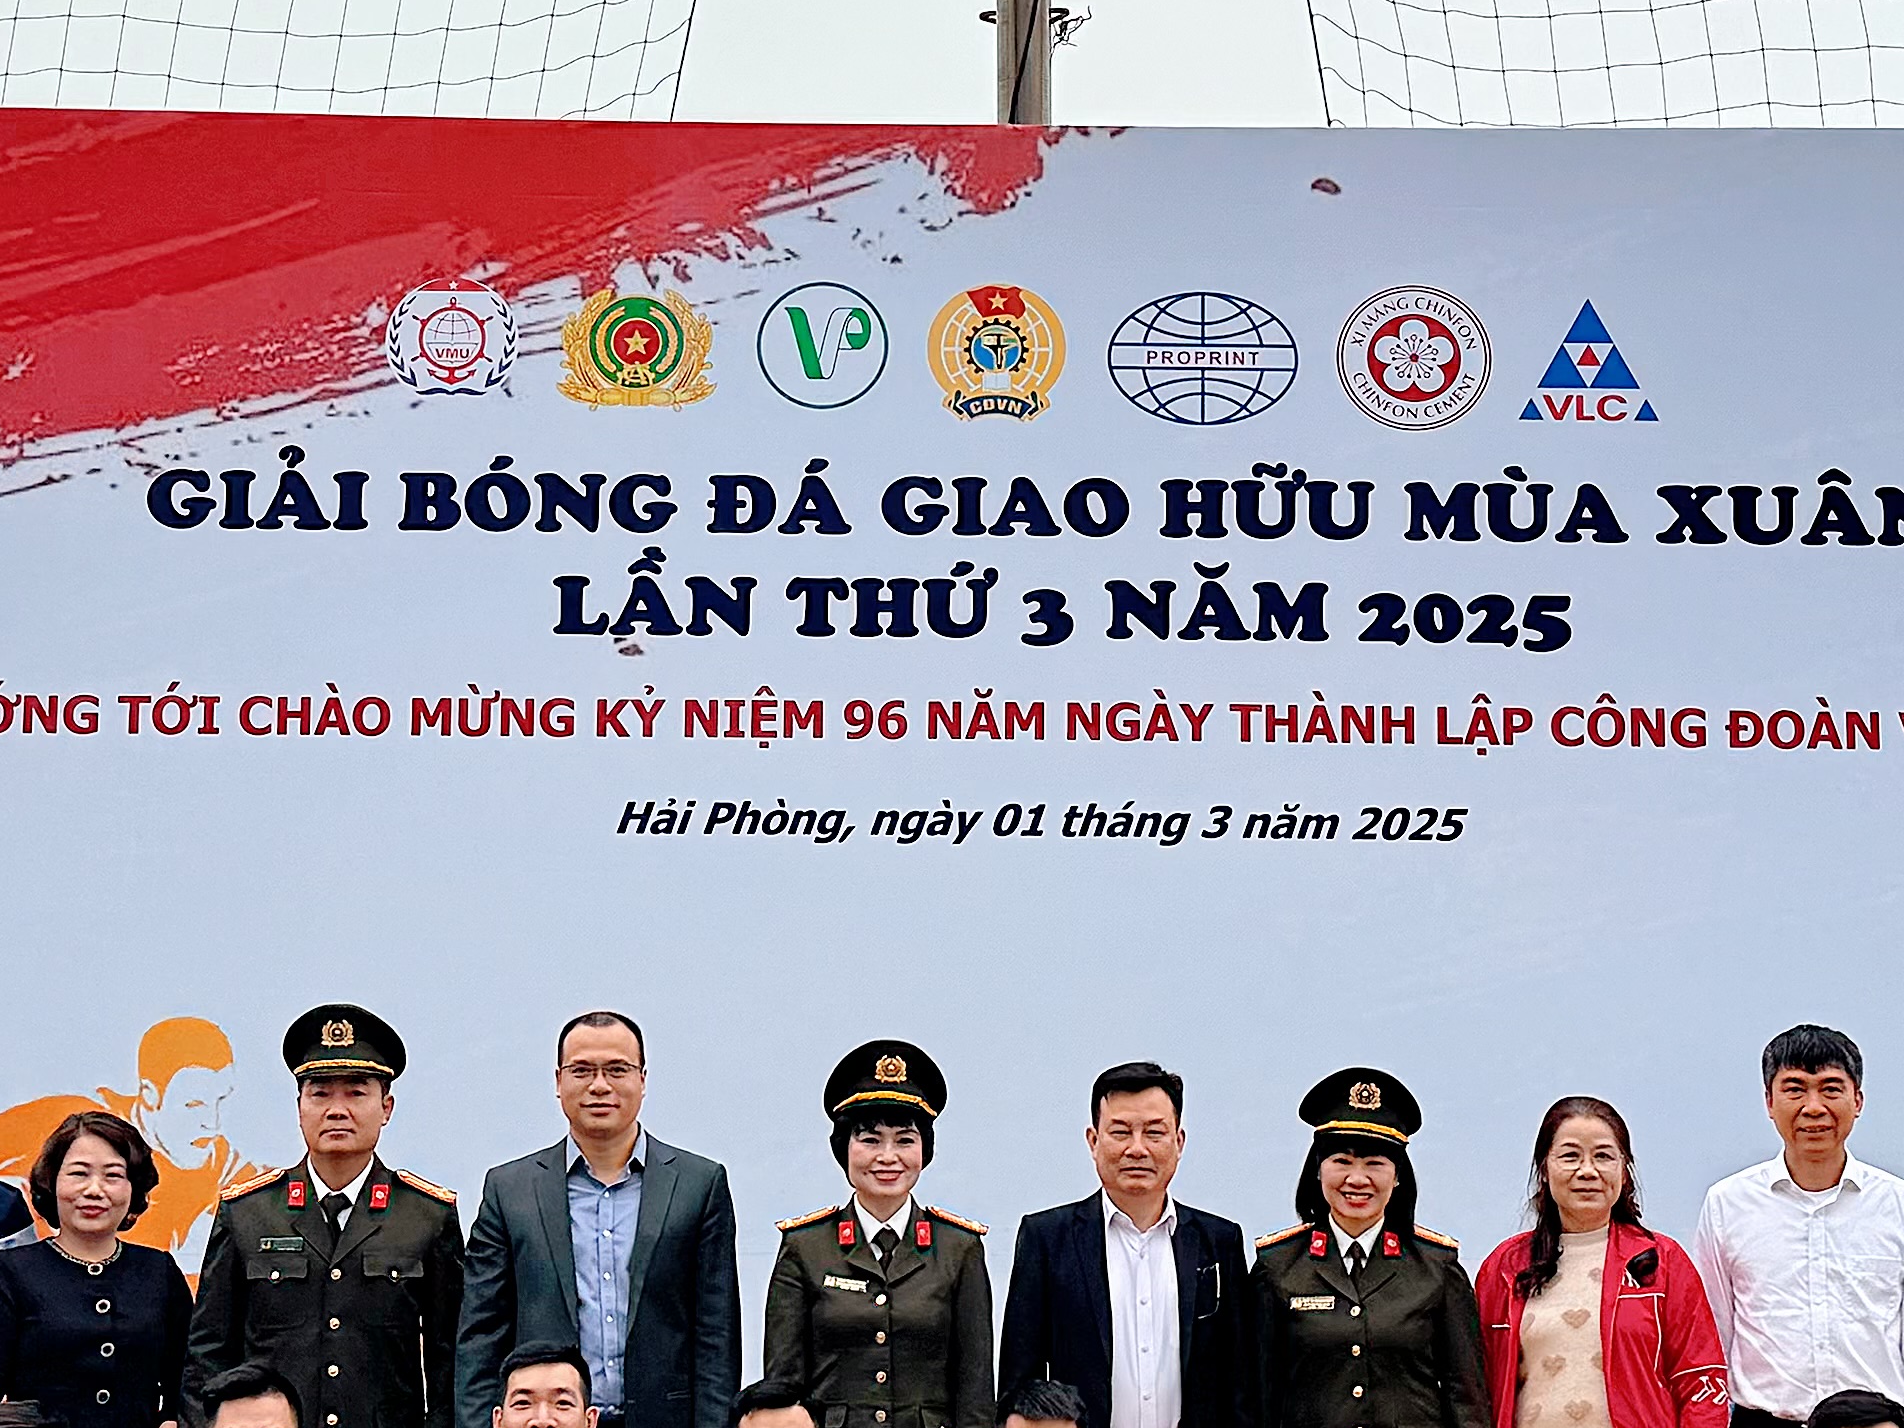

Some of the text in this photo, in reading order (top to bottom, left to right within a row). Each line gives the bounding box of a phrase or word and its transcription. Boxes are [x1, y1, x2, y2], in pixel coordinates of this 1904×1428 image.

[1350, 330, 1368, 348] XI
[1413, 296, 1478, 351] CHINFON
[434, 346, 471, 361] VMU
[1145, 348, 1260, 368] PROPRINT
[1352, 371, 1476, 420] CHINFON CEMENT
[1541, 393, 1629, 422] VLC
[145, 443, 371, 532] GIẢI
[396, 454, 680, 535] BÓNG
[705, 457, 854, 536] ĐÁ
[880, 474, 1131, 539] GIAO
[1158, 461, 1377, 542] HỮU
[1402, 464, 1631, 545] MÙA
[551, 545, 1573, 654] LẦN THỨ 3 NĂM 2025
[116, 680, 222, 737] TỚI
[238, 681, 392, 738] CHÀO
[409, 682, 576, 739] MỪNG
[595, 683, 667, 739] KỶ
[683, 684, 825, 750] NIỆM
[842, 698, 909, 741] 96
[926, 686, 1046, 742] NĂM
[1065, 687, 1215, 743] NGÀY
[1231, 689, 1417, 747] THÀNH
[1435, 691, 1535, 757] LẬP
[1549, 691, 1708, 750] CÔNG
[1723, 695, 1882, 751] ĐOÀN
[615, 796, 1470, 848] Hải Phòng, ngày 01 tháng 3 năm 2025
